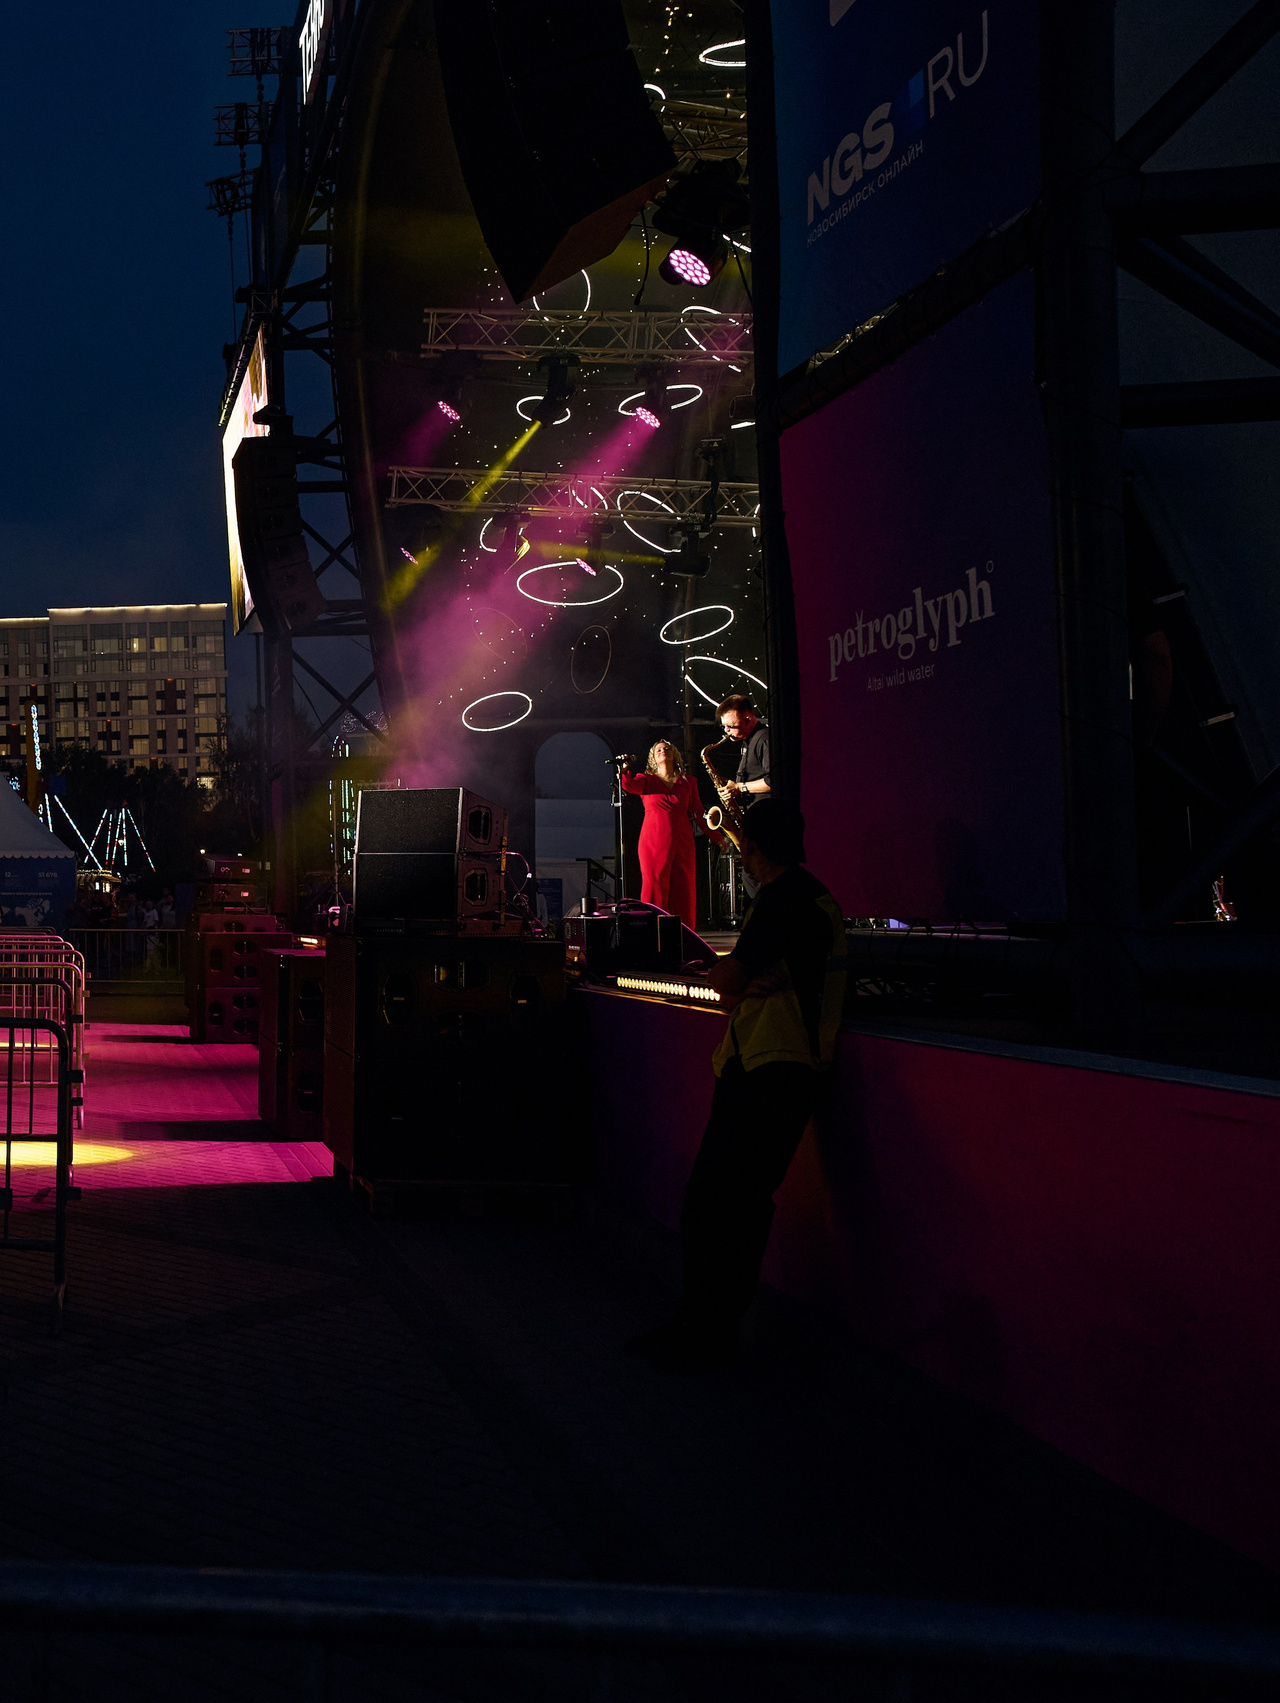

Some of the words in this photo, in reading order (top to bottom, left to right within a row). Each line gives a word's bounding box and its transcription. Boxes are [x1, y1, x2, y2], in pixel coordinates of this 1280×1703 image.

[806, 101, 895, 226] NGS
[927, 9, 989, 119] RU
[806, 180, 876, 249] НОВОСИБИРСК
[877, 139, 925, 188] ОНЛАЙН
[828, 566, 996, 682] petroglyph
[867, 673, 884, 692] Altai
[885, 667, 906, 688] wild
[907, 663, 935, 683] water
